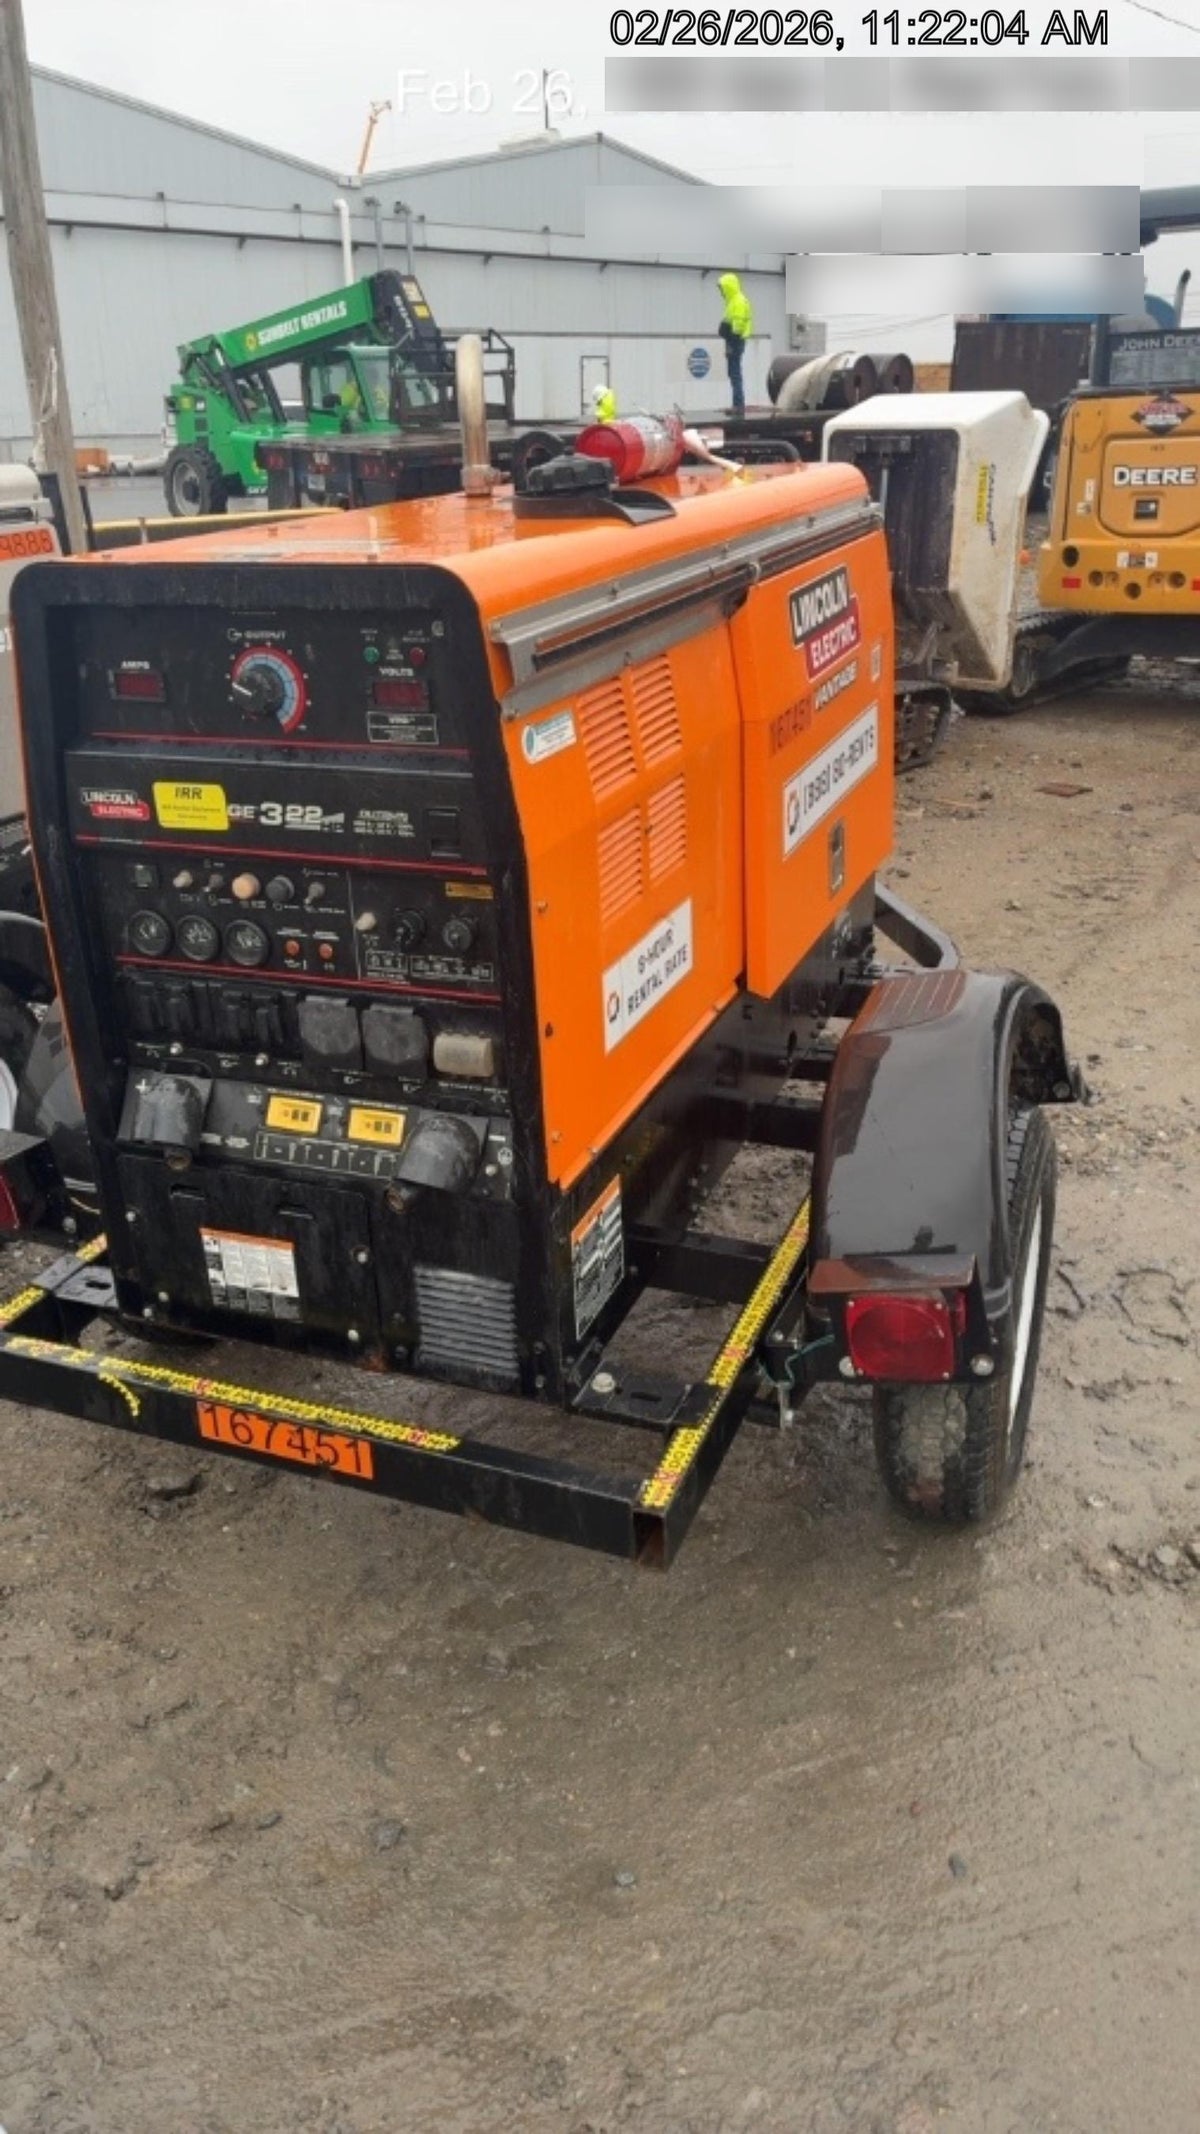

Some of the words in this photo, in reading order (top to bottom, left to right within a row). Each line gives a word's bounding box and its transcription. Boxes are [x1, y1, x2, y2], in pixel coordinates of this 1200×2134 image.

[1113, 465, 1197, 486] DEERE
[791, 573, 848, 639] LINCOLN
[810, 615, 857, 669] ELECTRIC
[120, 661, 150, 670] AMPS
[82, 791, 135, 805] LINCOLN
[174, 786, 203, 800] IRR
[96, 805, 144, 817] ELECTRIC
[260, 801, 323, 826] 322
[202, 1402, 363, 1474] 167451
